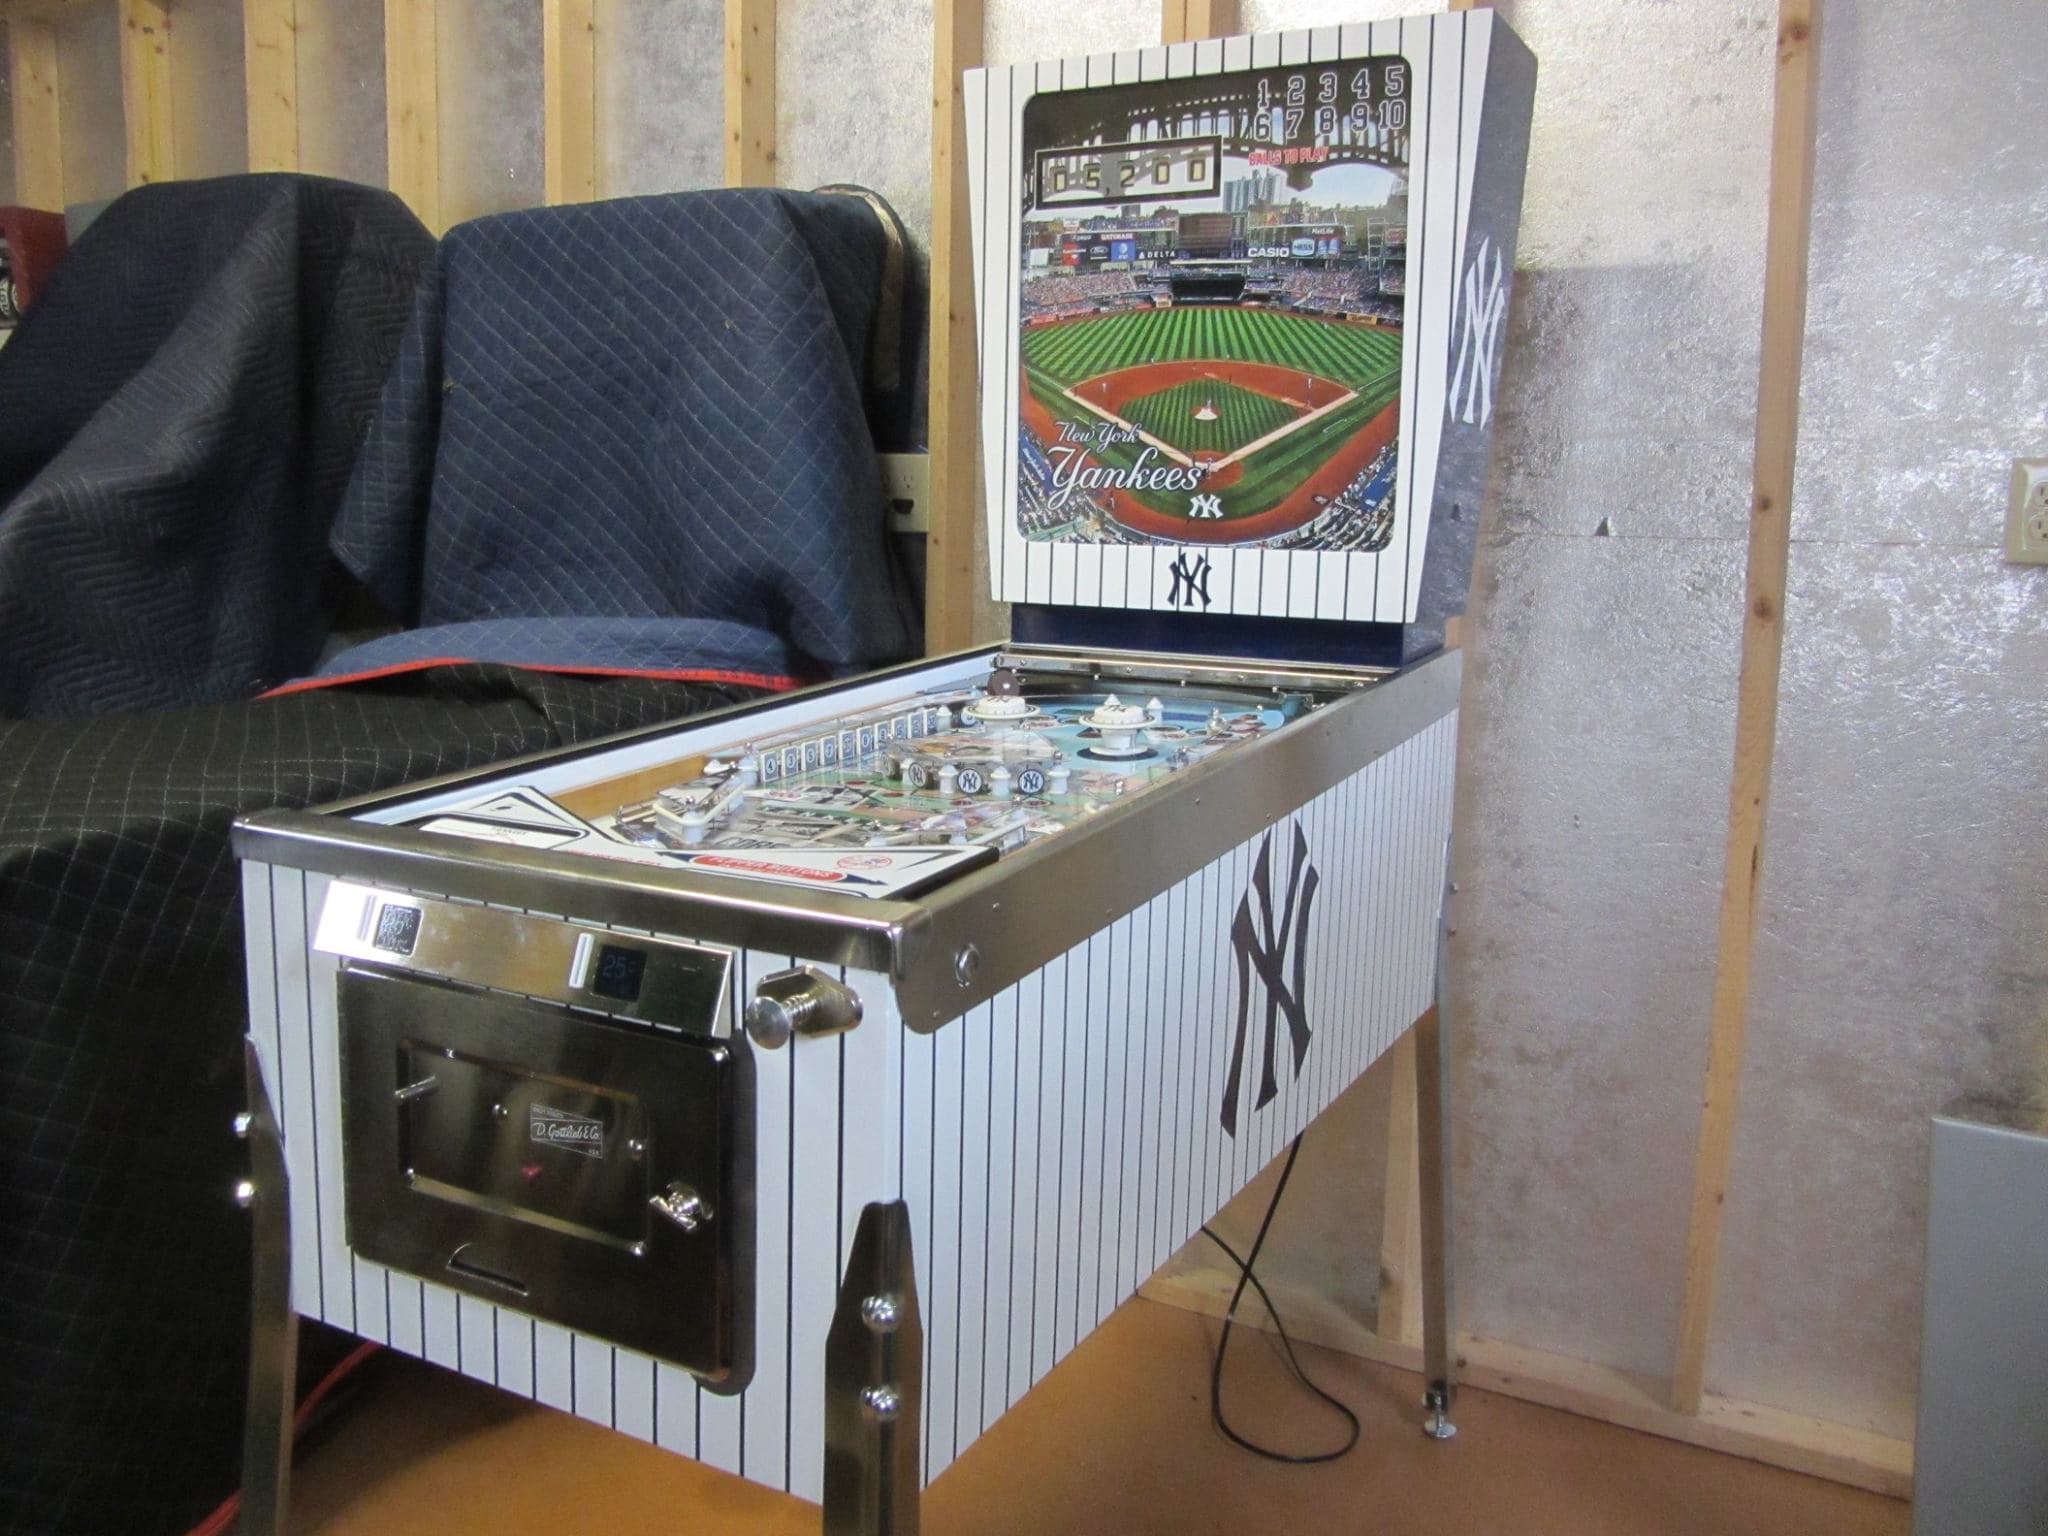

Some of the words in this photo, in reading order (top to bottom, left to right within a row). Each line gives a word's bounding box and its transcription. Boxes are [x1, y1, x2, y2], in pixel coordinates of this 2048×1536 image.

[1258, 78, 1269, 109] 1
[1287, 75, 1305, 106] 2
[1319, 72, 1337, 102] 3
[1352, 68, 1369, 99] 4
[1385, 65, 1404, 96] 5
[1254, 111, 1271, 141] 6
[1286, 108, 1304, 138] 7
[1319, 106, 1336, 135] 8
[1352, 102, 1369, 132] 9
[1378, 99, 1406, 130] 10
[1248, 150, 1282, 166] BALLS
[1283, 148, 1298, 163] TO
[1300, 146, 1330, 162] PLAY
[1147, 250, 1176, 258] DELTA
[1247, 247, 1290, 258] CASIO
[1055, 421, 1094, 443] New
[1098, 422, 1140, 454] York
[1046, 445, 1202, 511] Yankees
[1167, 552, 1212, 608] NY
[1220, 816, 1319, 1139] NY
